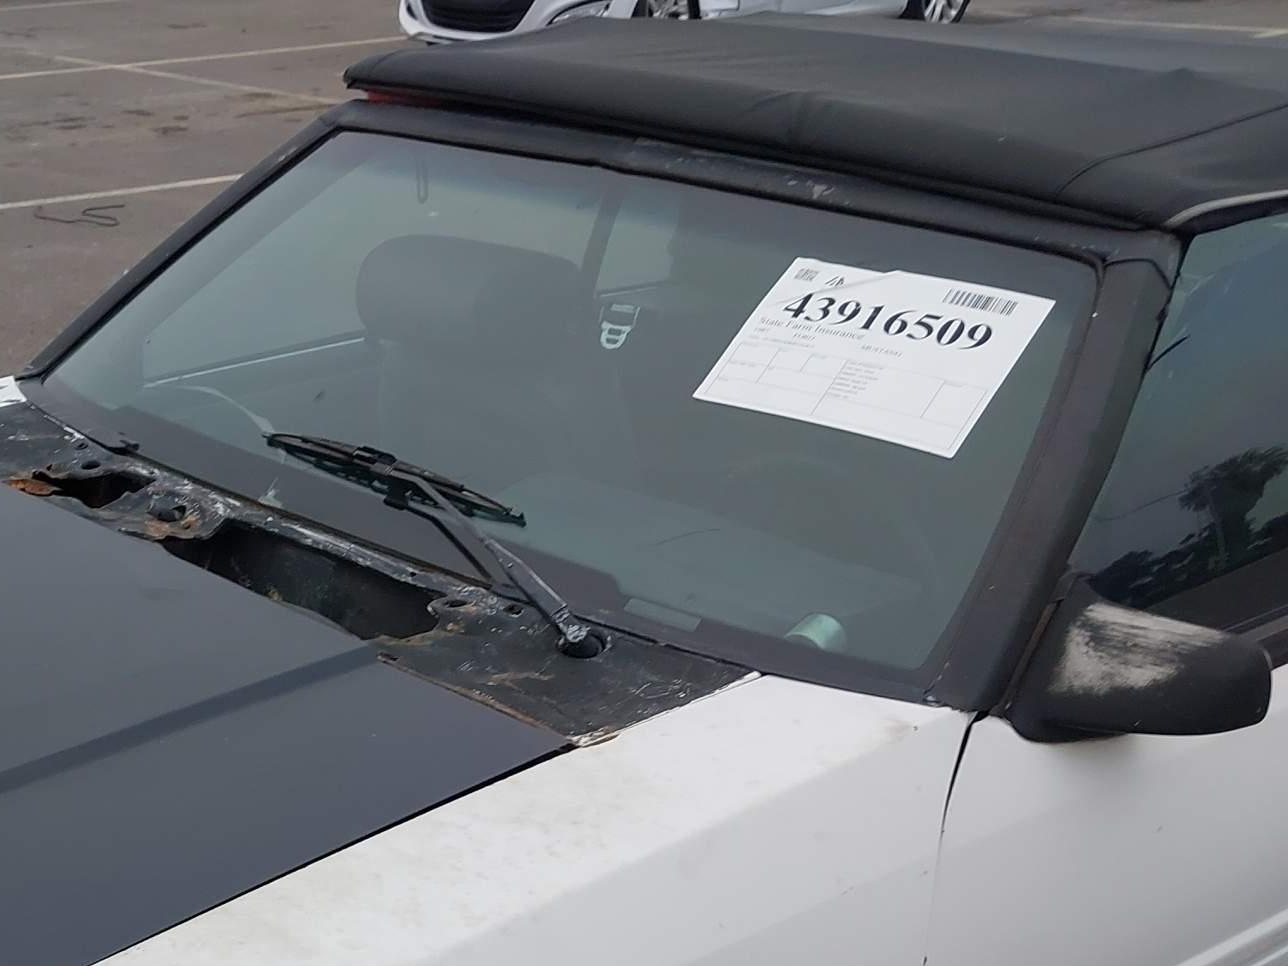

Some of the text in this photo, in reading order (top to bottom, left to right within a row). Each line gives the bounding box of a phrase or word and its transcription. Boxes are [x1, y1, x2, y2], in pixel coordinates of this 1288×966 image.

[760, 318, 865, 340] State Farm Insurance
[783, 291, 993, 350] 43916509
